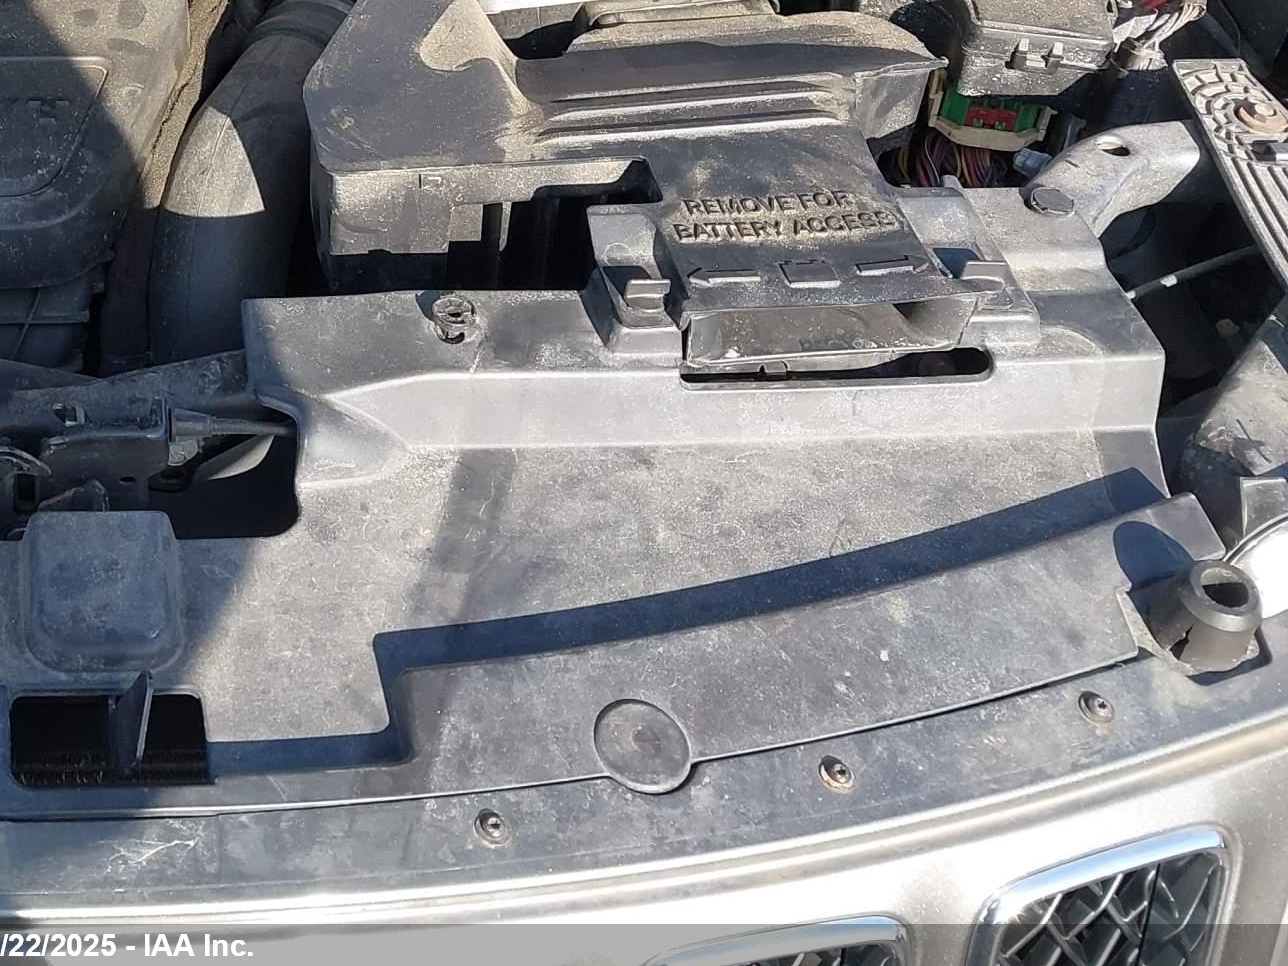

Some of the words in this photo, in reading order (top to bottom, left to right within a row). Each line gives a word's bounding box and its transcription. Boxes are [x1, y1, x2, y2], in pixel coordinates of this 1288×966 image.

[683, 194, 796, 216] REMOVE
[799, 189, 855, 210] FOR
[672, 218, 785, 241] BATTERY
[792, 210, 899, 236] ACCESS
